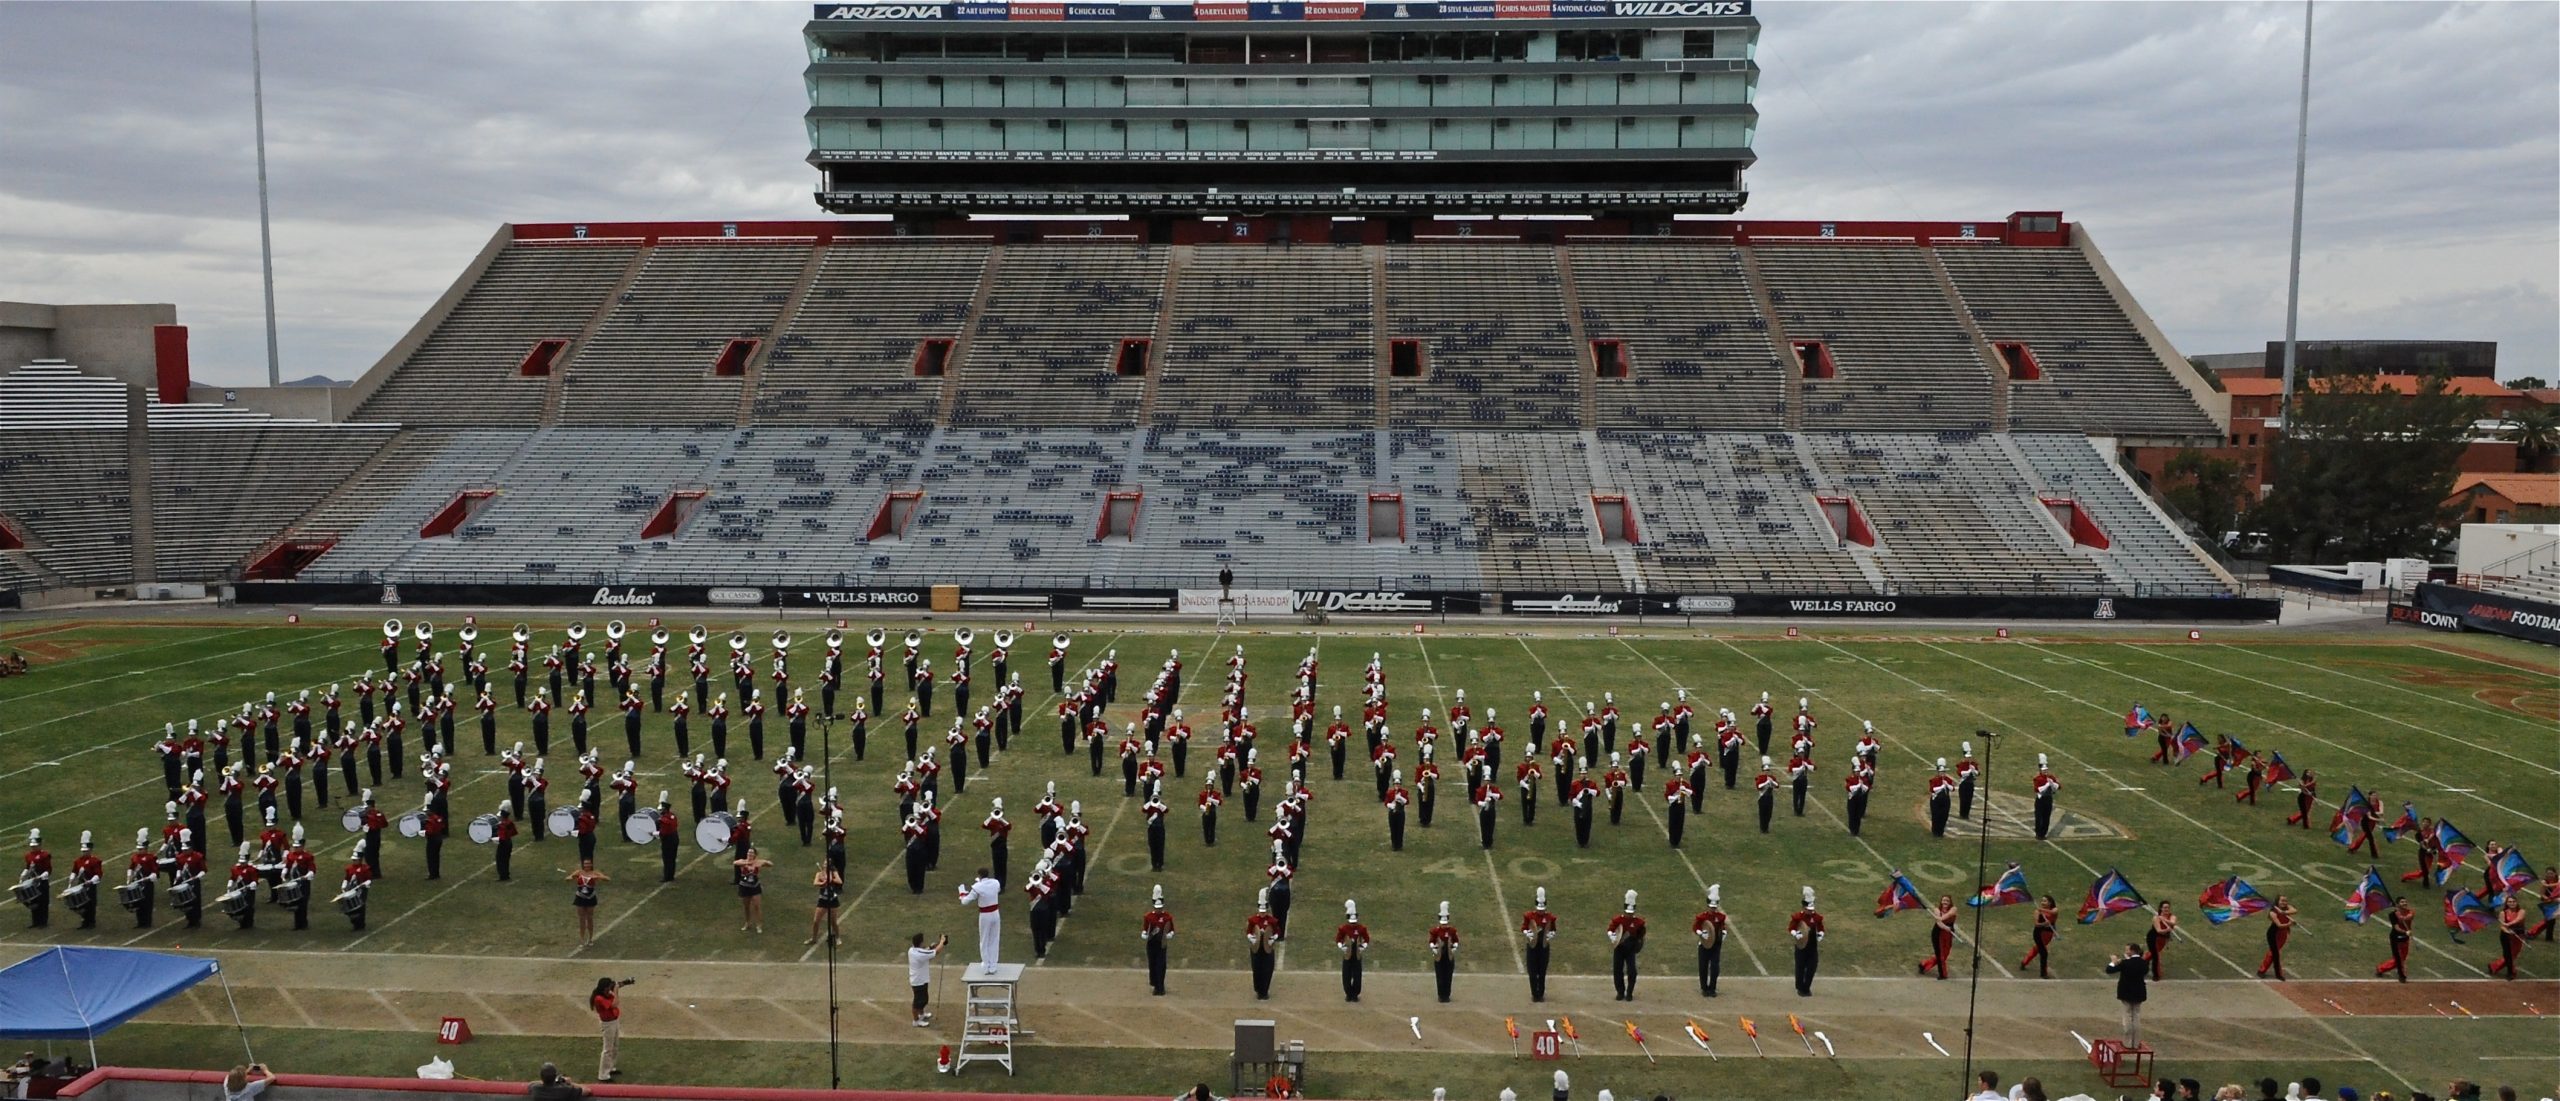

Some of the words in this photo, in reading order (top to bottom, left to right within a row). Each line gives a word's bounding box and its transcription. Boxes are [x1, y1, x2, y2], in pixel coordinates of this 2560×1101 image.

[827, 6, 942, 19] ARIZONA
[1614, 2, 1744, 15] WILDCATS
[576, 230, 586, 238] 17
[725, 229, 736, 237] 18
[895, 228, 906, 236] 19
[1088, 227, 1101, 236] 20
[1236, 226, 1247, 236] 21
[1458, 227, 1471, 236] 22
[1658, 227, 1671, 236] 23
[1821, 228, 1834, 237] 24
[1961, 229, 1974, 238] 25
[225, 391, 236, 400] 16
[592, 587, 656, 605] Bashas'
[816, 592, 867, 603] WELLS
[870, 592, 919, 603] FARGO
[1181, 596, 1216, 607] UNIVERSITY
[1257, 596, 1276, 606] BAND
[1277, 596, 1289, 606] DAY
[1790, 600, 1843, 611] WELLS
[1846, 600, 1896, 611] FARGO
[2421, 611, 2458, 629] DOWN
[441, 1021, 459, 1040] 40
[1536, 1036, 1555, 1056] 40
